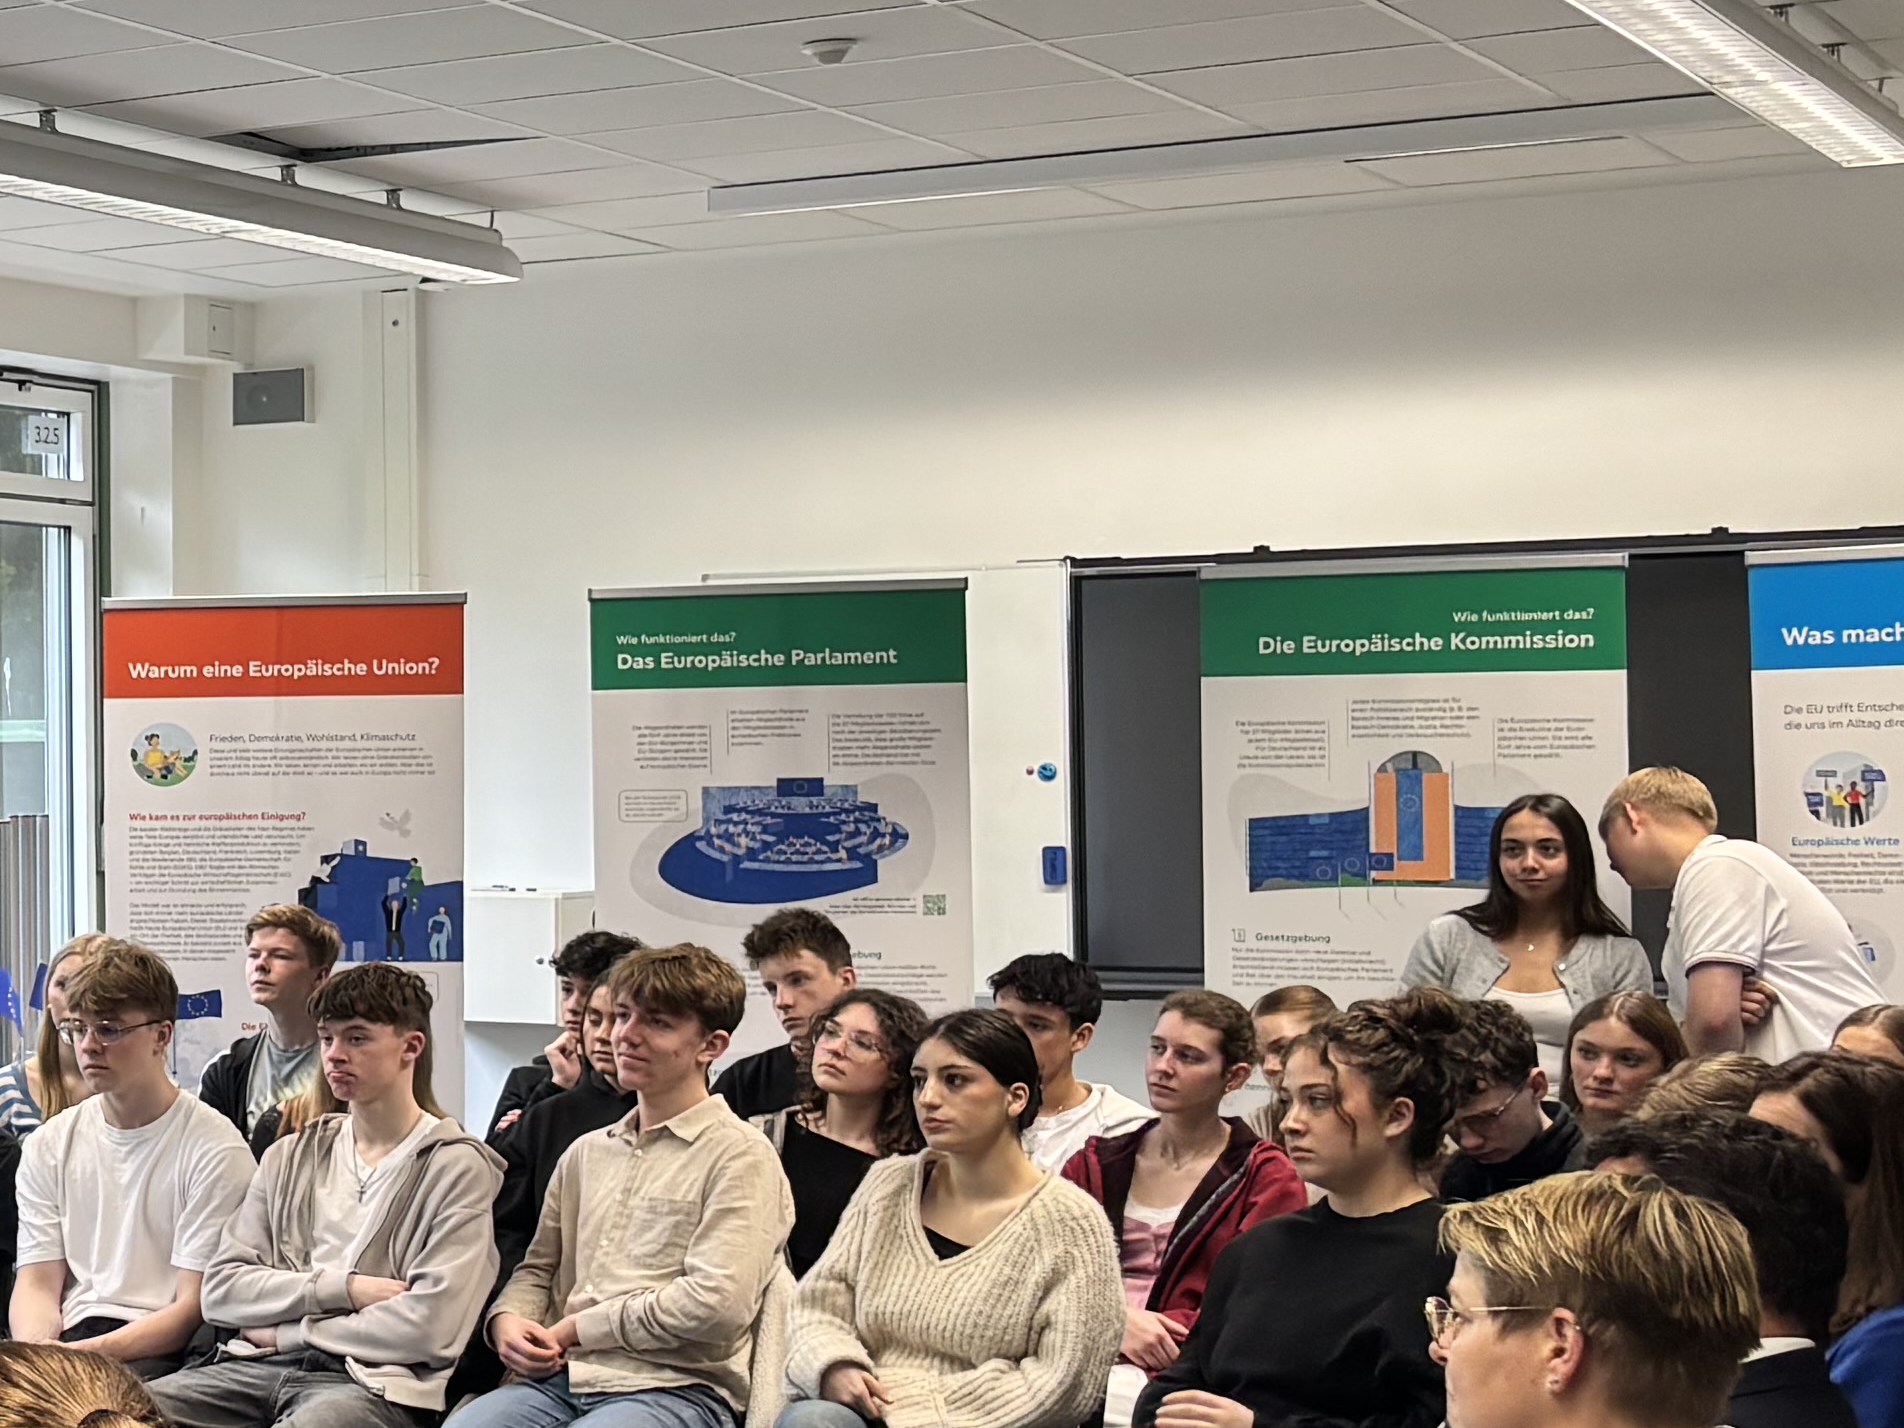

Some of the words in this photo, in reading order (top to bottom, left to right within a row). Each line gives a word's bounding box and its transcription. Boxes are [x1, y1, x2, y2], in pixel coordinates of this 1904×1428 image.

[1452, 611, 1479, 623] Wie
[1563, 607, 1595, 620] das?
[616, 634, 638, 645] Wie
[640, 633, 708, 644] funktioniert
[710, 631, 737, 643] das?
[1258, 636, 1296, 654] Die
[1302, 631, 1444, 656] Europäische
[1450, 629, 1595, 651] Kommission
[1781, 626, 1836, 646] Was
[617, 653, 655, 670] Das
[660, 648, 786, 672] Europäische
[791, 647, 898, 666] Parlament
[127, 661, 198, 679] Warum
[202, 660, 244, 678] eine
[248, 658, 368, 680] Europäische
[372, 656, 440, 676] Union?
[1783, 704, 1804, 715] Die
[1806, 704, 1824, 714] EU
[1826, 702, 1854, 713] trifft
[1783, 720, 1802, 731] die
[1805, 721, 1826, 730] uns
[1863, 836, 1900, 847] Werte
[1255, 932, 1331, 944] Gesetzgebung
